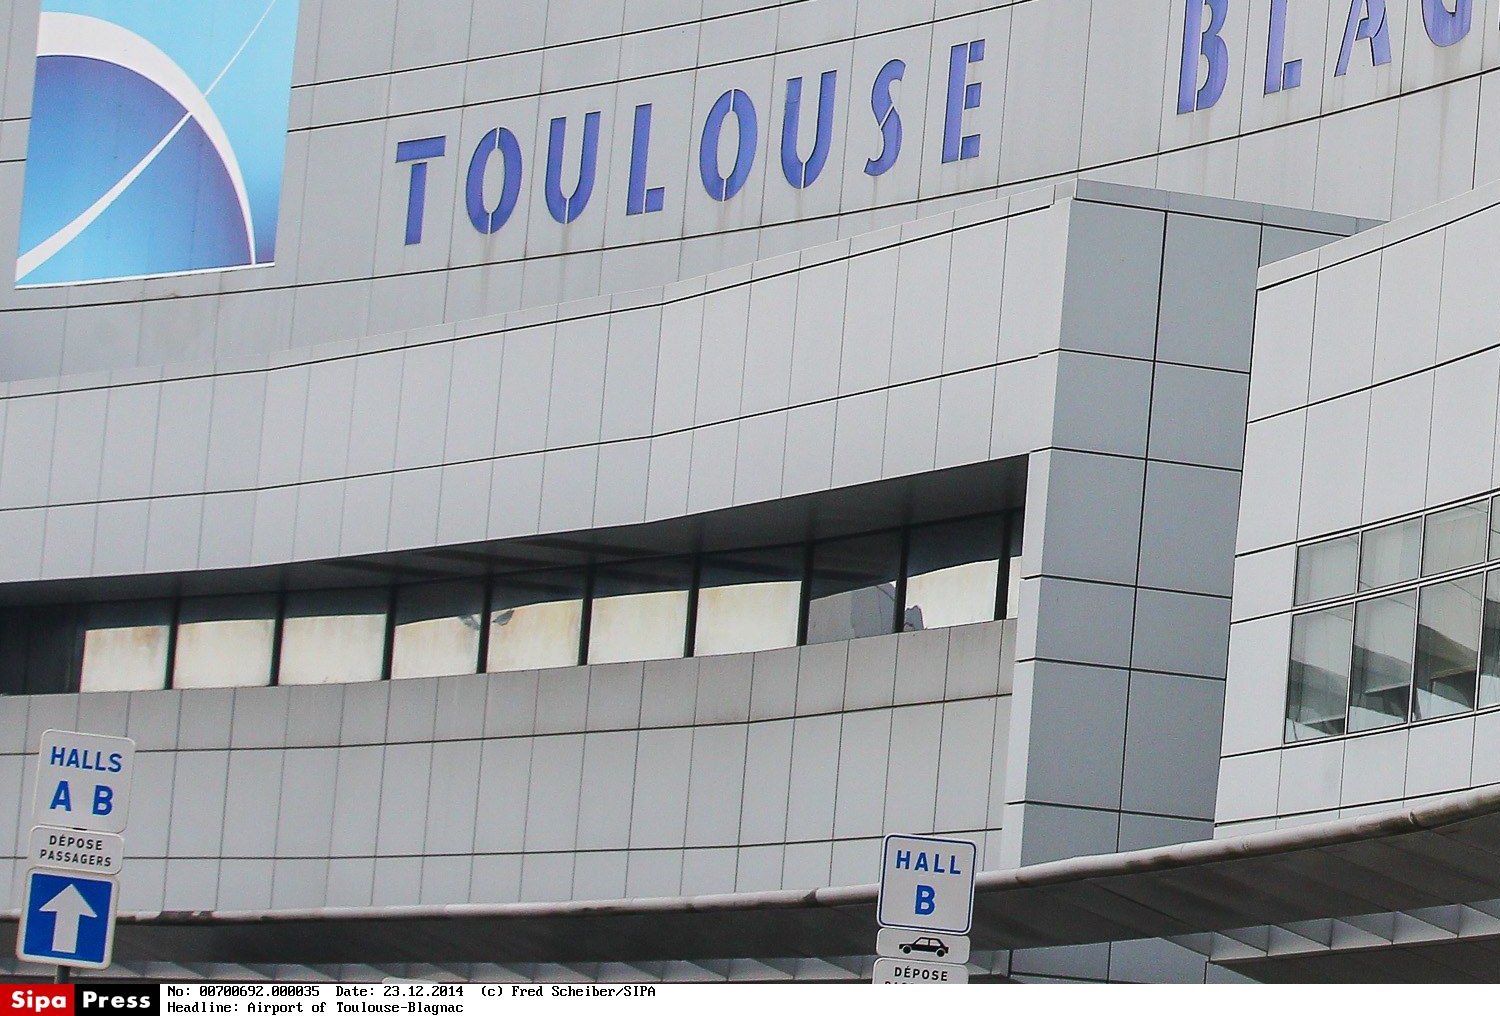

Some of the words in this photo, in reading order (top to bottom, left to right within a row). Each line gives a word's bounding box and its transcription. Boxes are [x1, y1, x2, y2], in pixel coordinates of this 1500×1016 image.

[396, 39, 985, 245] TOULOUSE
[50, 745, 123, 773] HALLS
[49, 780, 72, 812] A
[92, 784, 114, 817] B
[49, 834, 103, 851] DÉPOSE
[40, 849, 112, 867] PASSAGERS
[895, 849, 962, 876] HALL
[914, 884, 936, 916] B
[894, 965, 949, 982] DÉPOSE
